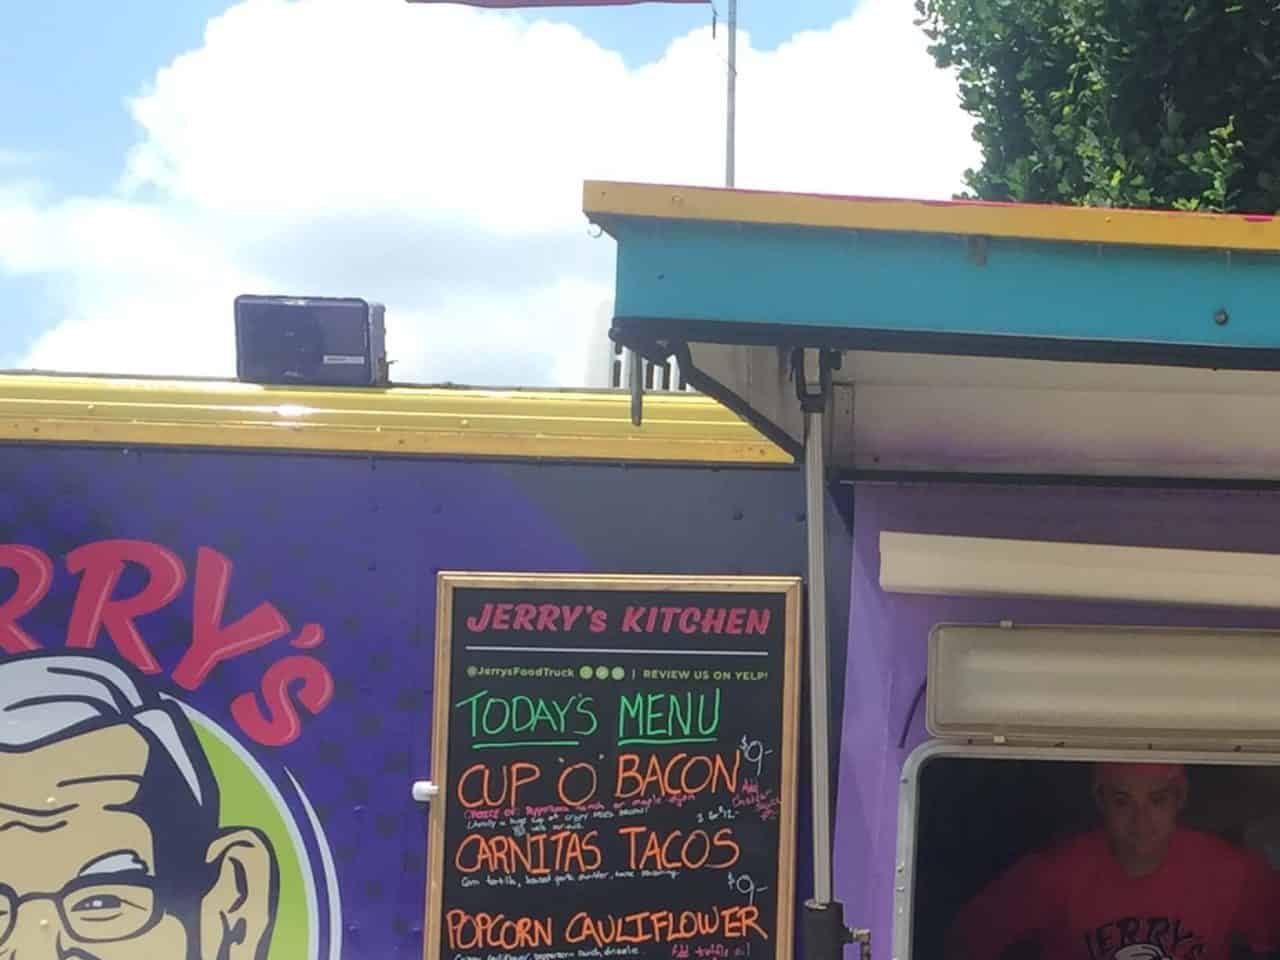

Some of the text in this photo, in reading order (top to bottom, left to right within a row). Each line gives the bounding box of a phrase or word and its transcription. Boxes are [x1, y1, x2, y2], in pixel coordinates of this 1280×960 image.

[466, 603, 771, 635] JERRY's KITCHEN
[466, 665, 769, 680] @JerrysFoodTruck REVIEW US ON YELP!
[456, 688, 721, 738] TODAY'S MENU
[457, 762, 541, 808] CUP
[615, 748, 742, 798] BACON
[455, 826, 741, 874] CARNITAS TACOS
[446, 905, 769, 950] POPCORN CAULIFLOWER
